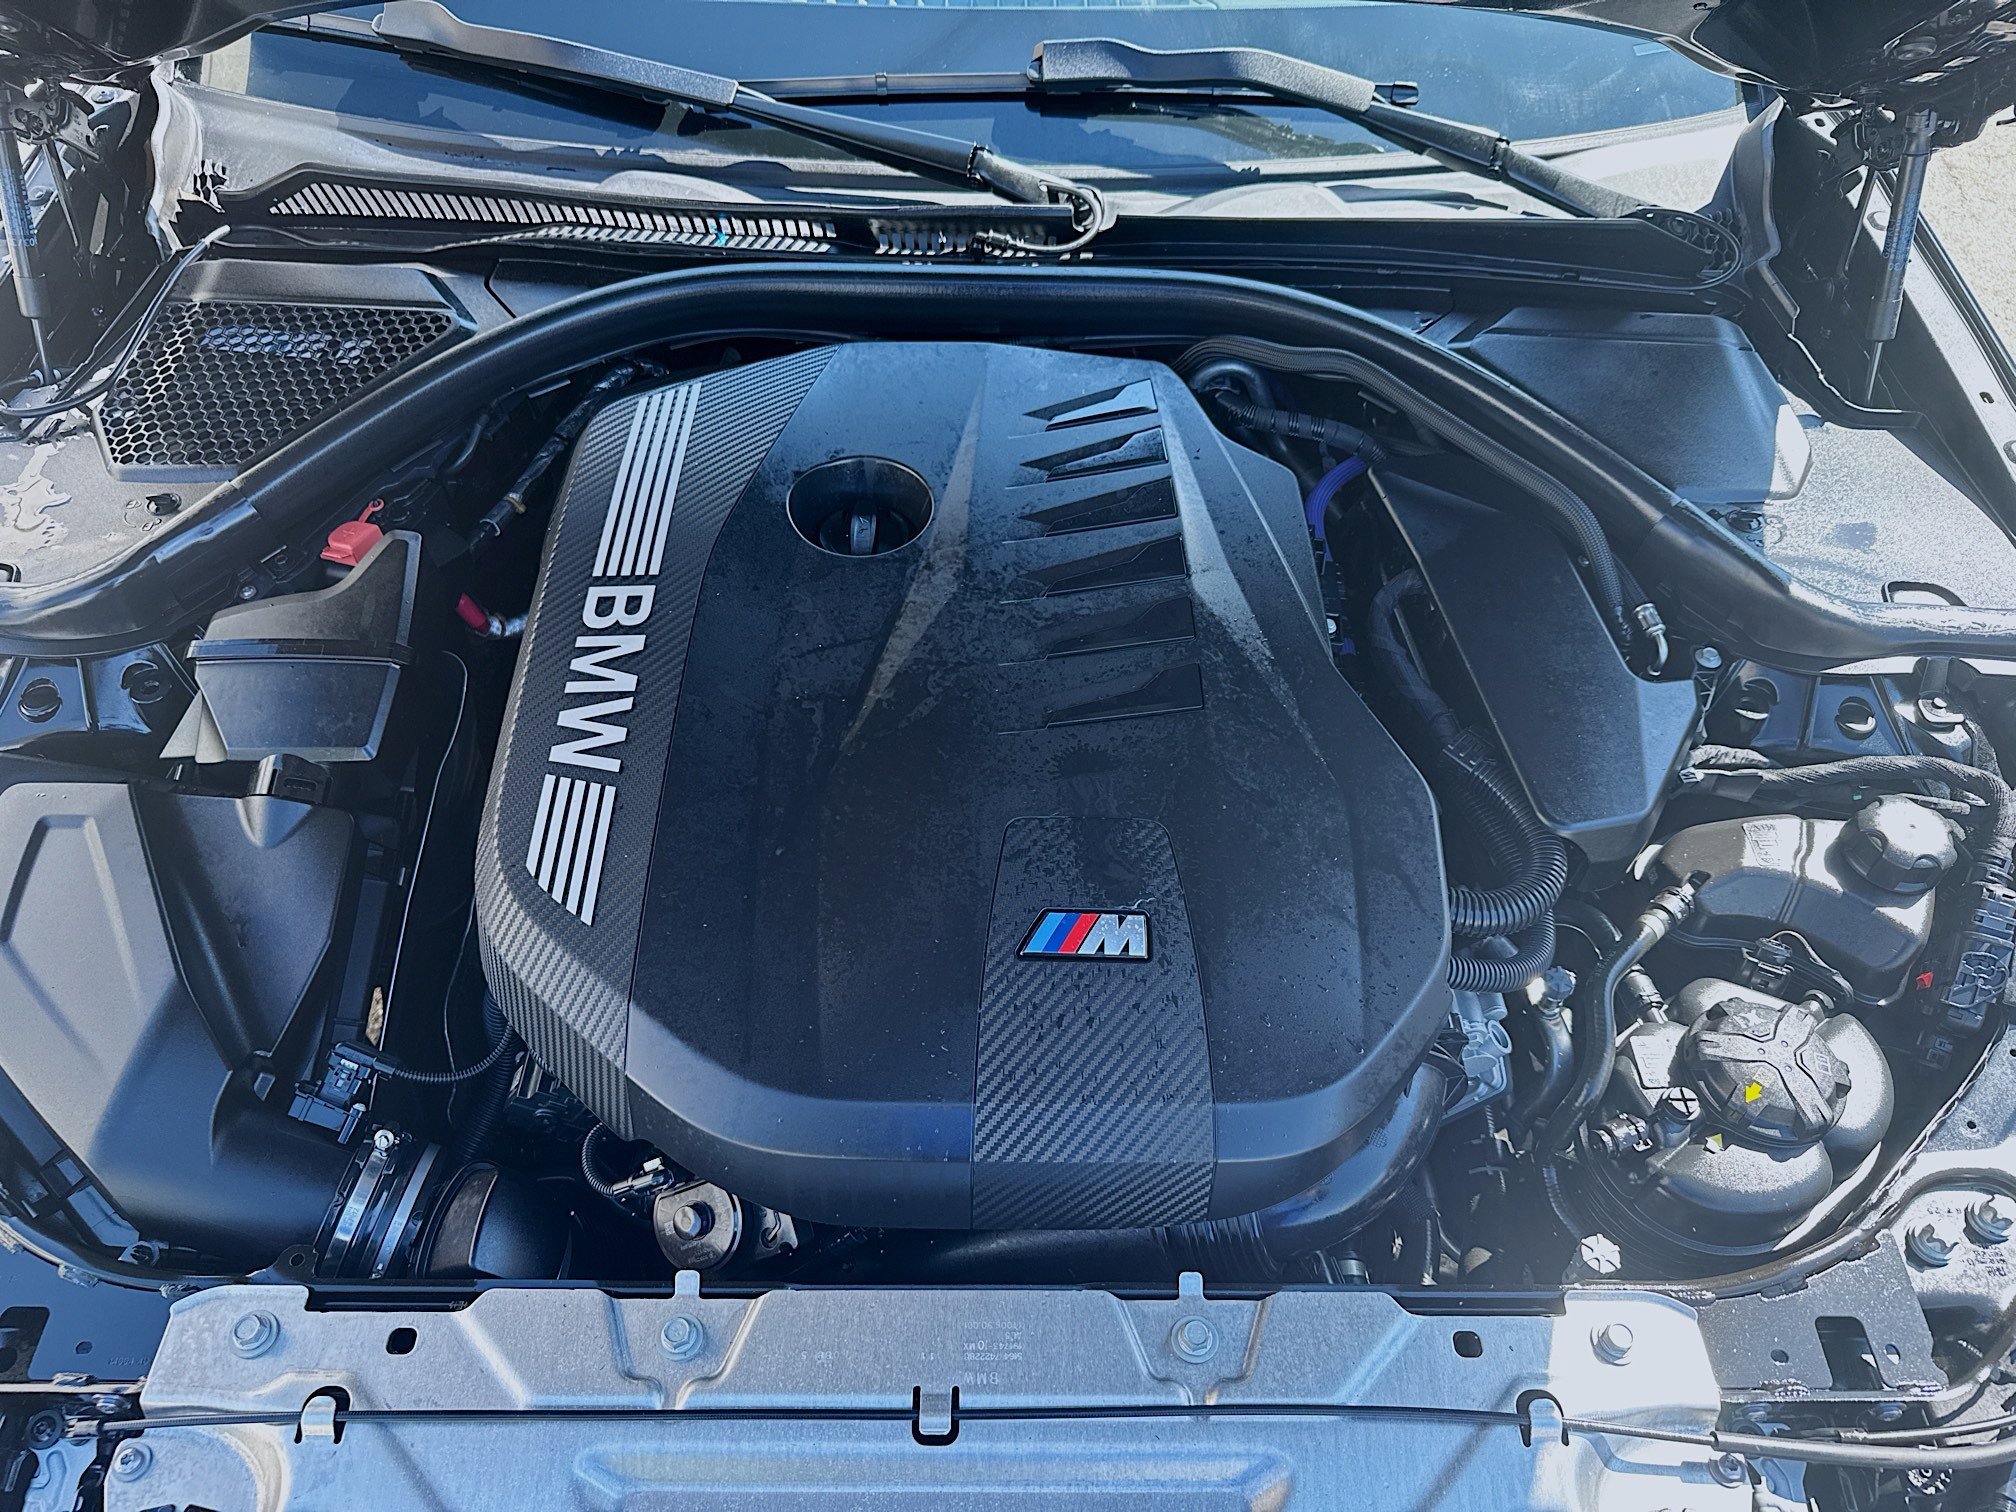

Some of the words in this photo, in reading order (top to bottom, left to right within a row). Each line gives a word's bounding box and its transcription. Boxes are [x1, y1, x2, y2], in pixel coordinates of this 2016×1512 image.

[549, 585, 656, 772] BMW
[1077, 913, 1146, 956] M
[964, 1372, 998, 1384] BMW
